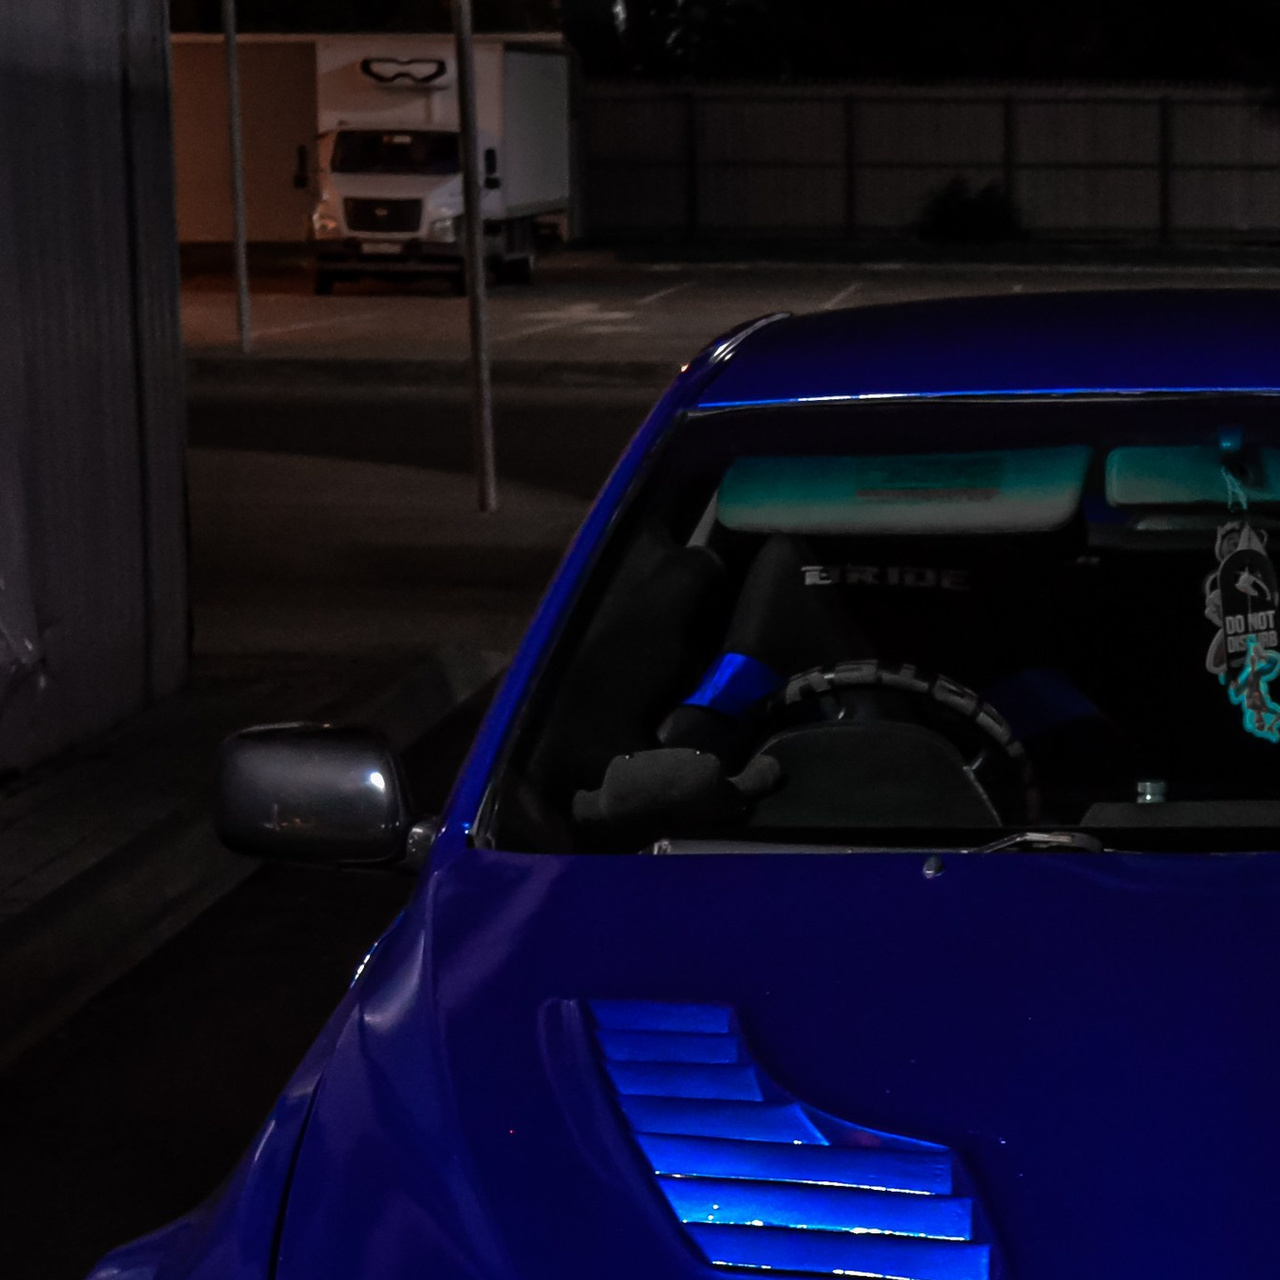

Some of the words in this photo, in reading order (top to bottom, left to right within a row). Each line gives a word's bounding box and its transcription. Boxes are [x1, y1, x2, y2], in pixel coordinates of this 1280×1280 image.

[800, 563, 970, 592] BRIDE
[1225, 615, 1245, 634] DO
[1247, 610, 1276, 632] NOT
[1227, 630, 1278, 653] DISRB
